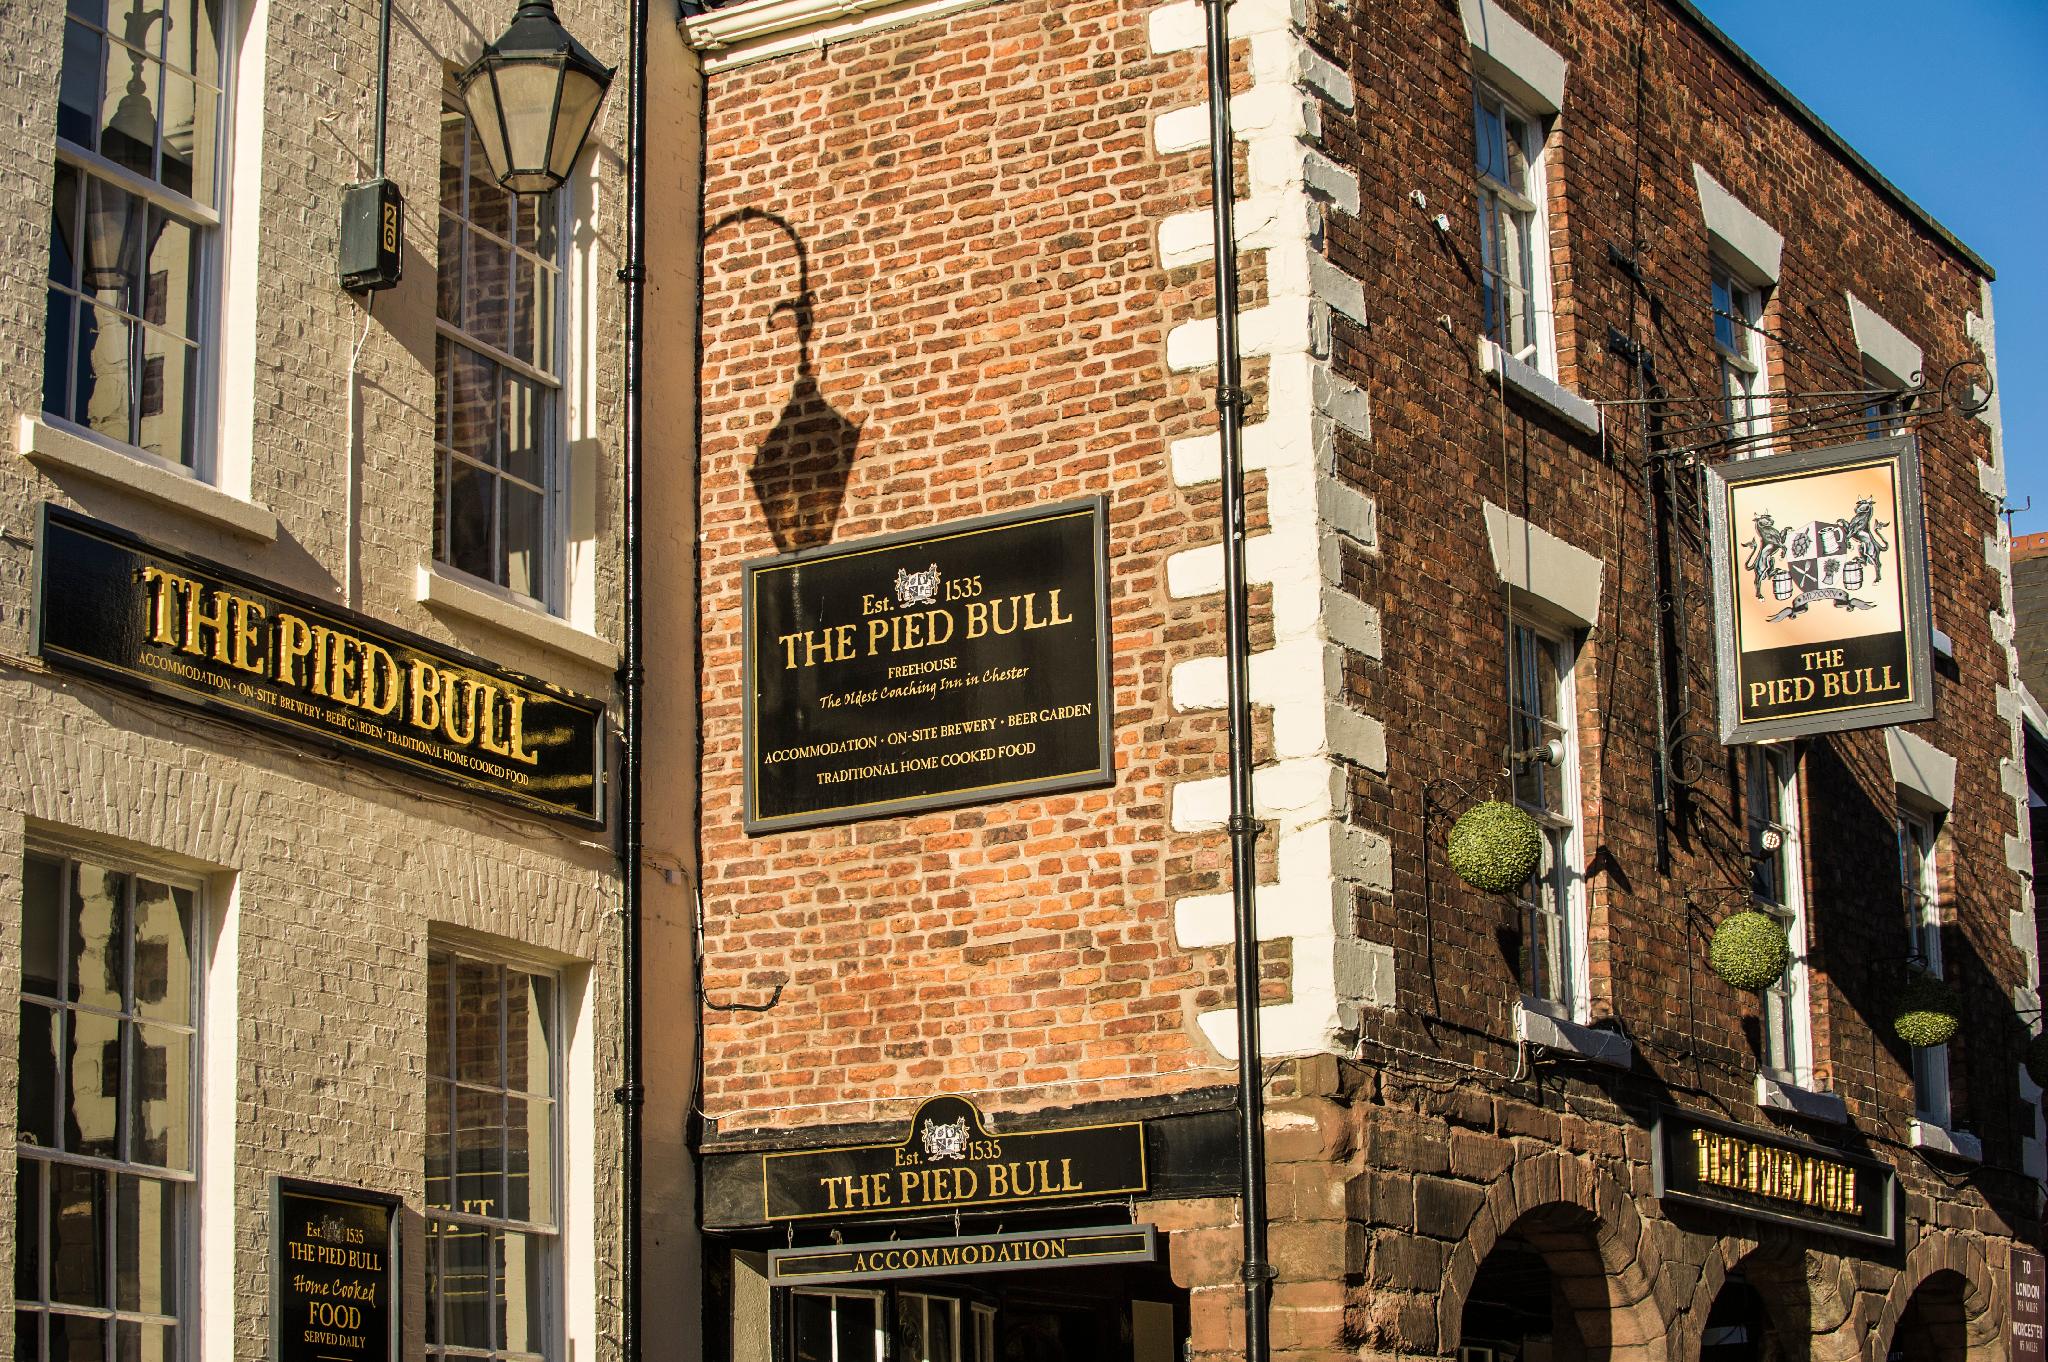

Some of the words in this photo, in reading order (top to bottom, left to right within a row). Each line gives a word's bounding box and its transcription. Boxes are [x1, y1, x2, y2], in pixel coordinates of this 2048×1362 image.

[386, 206, 394, 247] 26
[862, 594, 894, 616] Est.
[945, 575, 982, 602] 1535
[778, 624, 856, 669] THE
[867, 608, 954, 656] PIED
[965, 589, 1073, 639] BULL
[144, 566, 266, 675] THE
[275, 613, 398, 715] PIED
[409, 658, 538, 765] BULL
[888, 656, 957, 679] FREEHOUSE
[1801, 648, 1844, 671] THE
[819, 694, 842, 709] The
[844, 689, 878, 707] Oldest
[880, 679, 937, 700] Coaching
[940, 677, 963, 690] Inn
[965, 673, 980, 686] in
[982, 665, 1031, 683] Chester
[1750, 675, 1815, 708] PIED
[1822, 665, 1901, 699] BULL
[138, 651, 231, 690] ACCOMMODATION
[238, 683, 278, 706] ON-SITE
[280, 695, 322, 718] BREWERY
[326, 710, 347, 728] BEER
[347, 717, 383, 739] GARDEN
[387, 731, 442, 759] TRADITIONAL
[443, 748, 469, 768] HOME
[469, 757, 504, 778] COOKED
[505, 769, 529, 786] FOOD
[764, 736, 877, 765] ACCOMMODATION
[887, 726, 938, 746] ON-SITE
[941, 717, 997, 738] BREWERY
[1007, 711, 1038, 727] BEER
[1040, 703, 1092, 722] GARDEN
[817, 762, 899, 785] TRADITIONAL
[900, 756, 939, 772] HOME
[941, 748, 996, 766] COOKED
[998, 741, 1036, 758] FOOD
[895, 1148, 923, 1167] Est.
[969, 1139, 1002, 1161] 1535
[820, 1173, 890, 1210] THE
[900, 1167, 978, 1204] PIED
[987, 1158, 1083, 1198] BULL
[306, 1221, 323, 1238] Est.
[346, 1227, 364, 1244] 1535
[288, 1241, 315, 1262] THE
[318, 1246, 346, 1266] PIED
[348, 1250, 382, 1271] BULL
[854, 1238, 1069, 1272] ACCOMMODATION
[2022, 1260, 2031, 1274] TO
[293, 1274, 330, 1295] Home
[332, 1279, 376, 1308] Cooked
[2015, 1281, 2040, 1299] LONDON
[309, 1301, 361, 1330] FOOD
[2012, 1321, 2043, 1340] WORCESTER
[304, 1330, 338, 1345] SERVED
[339, 1334, 366, 1348] DAILY
